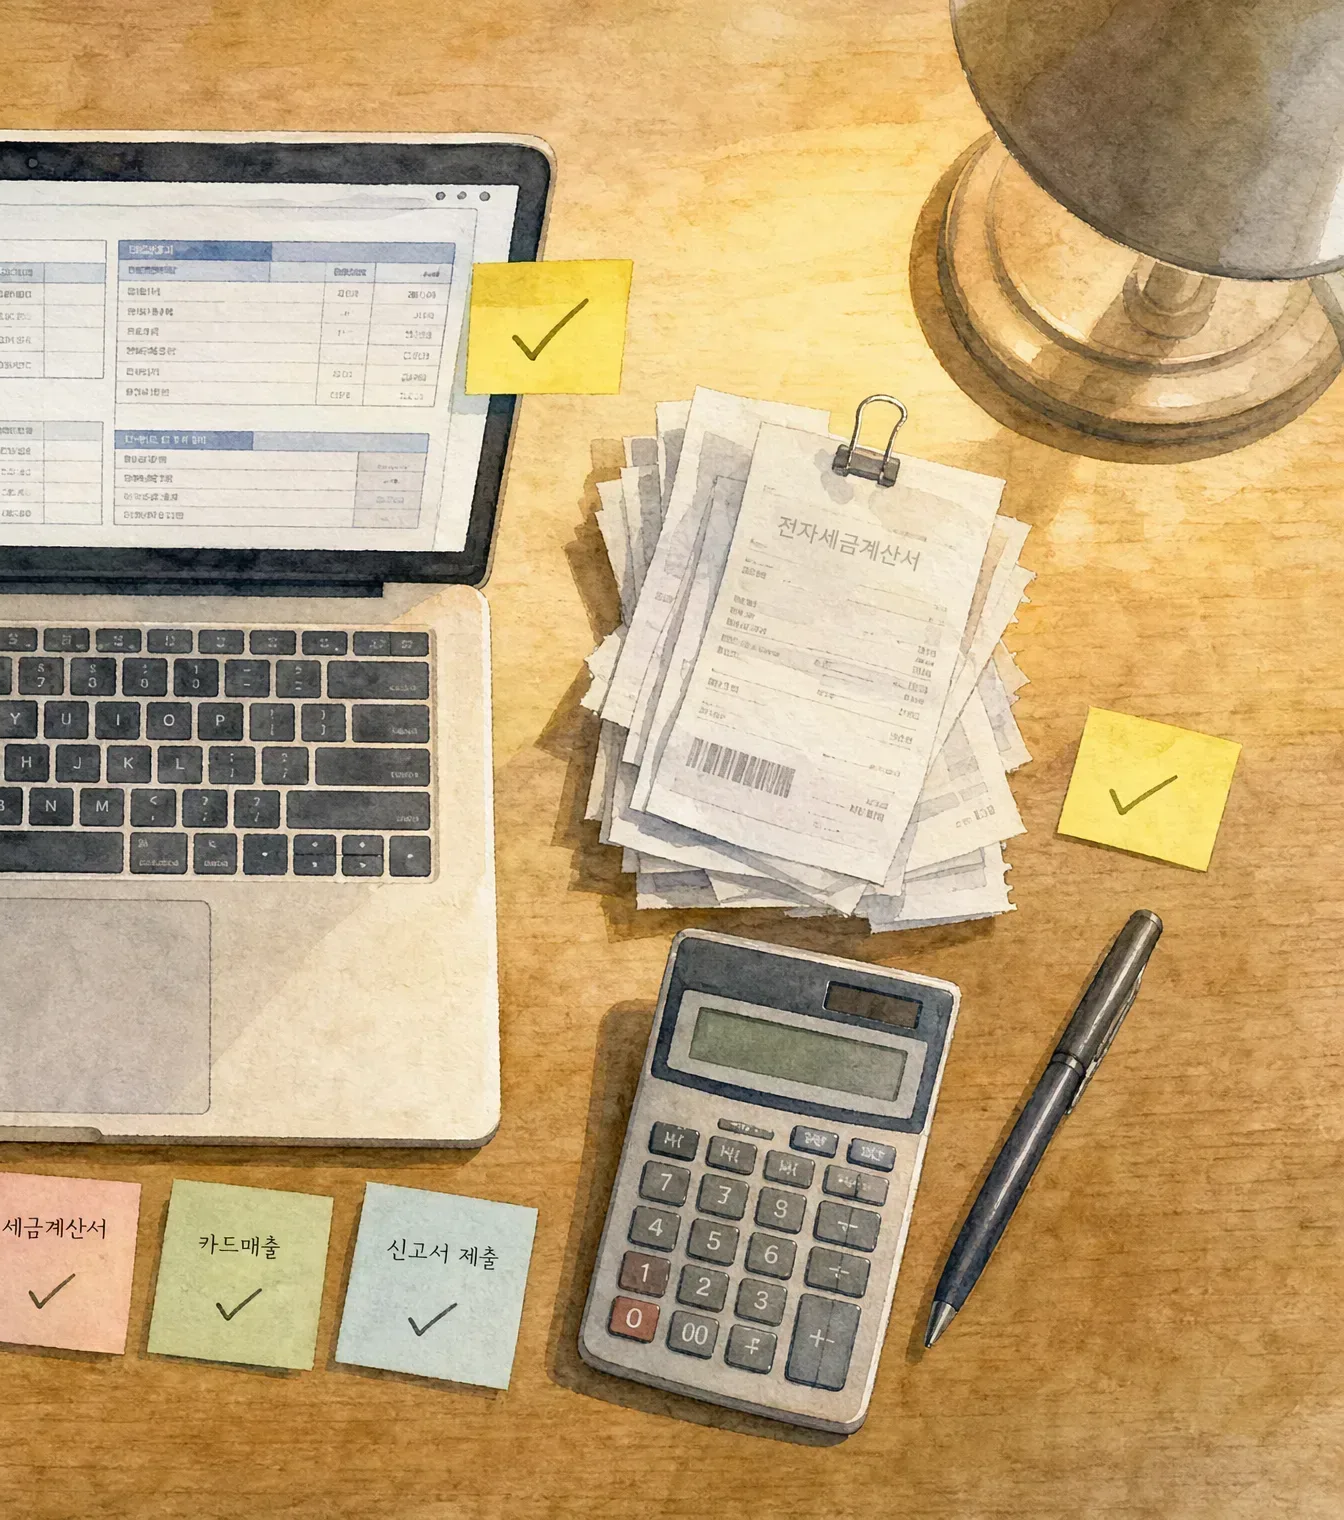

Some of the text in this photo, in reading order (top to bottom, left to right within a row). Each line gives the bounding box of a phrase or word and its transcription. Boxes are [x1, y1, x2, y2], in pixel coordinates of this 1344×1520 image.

[777, 515, 921, 572] 전자세금계산서
[9, 712, 21, 725] Y
[61, 712, 72, 726] U
[163, 713, 175, 727] O
[215, 714, 226, 727] P
[21, 755, 32, 769] H
[72, 756, 82, 770] J
[123, 756, 134, 770] K
[175, 757, 186, 770] L
[45, 799, 57, 812] N
[95, 800, 109, 813] M
[660, 1172, 673, 1192] 7
[717, 1185, 732, 1205] 3
[2, 1216, 106, 1240] 세금계산서
[647, 1218, 779, 1264] 4 5 6
[198, 1233, 281, 1260] 카드매출
[387, 1238, 499, 1271] 신고서 제출
[641, 1263, 769, 1310] 1 2 3
[625, 1307, 709, 1346] 0 00
